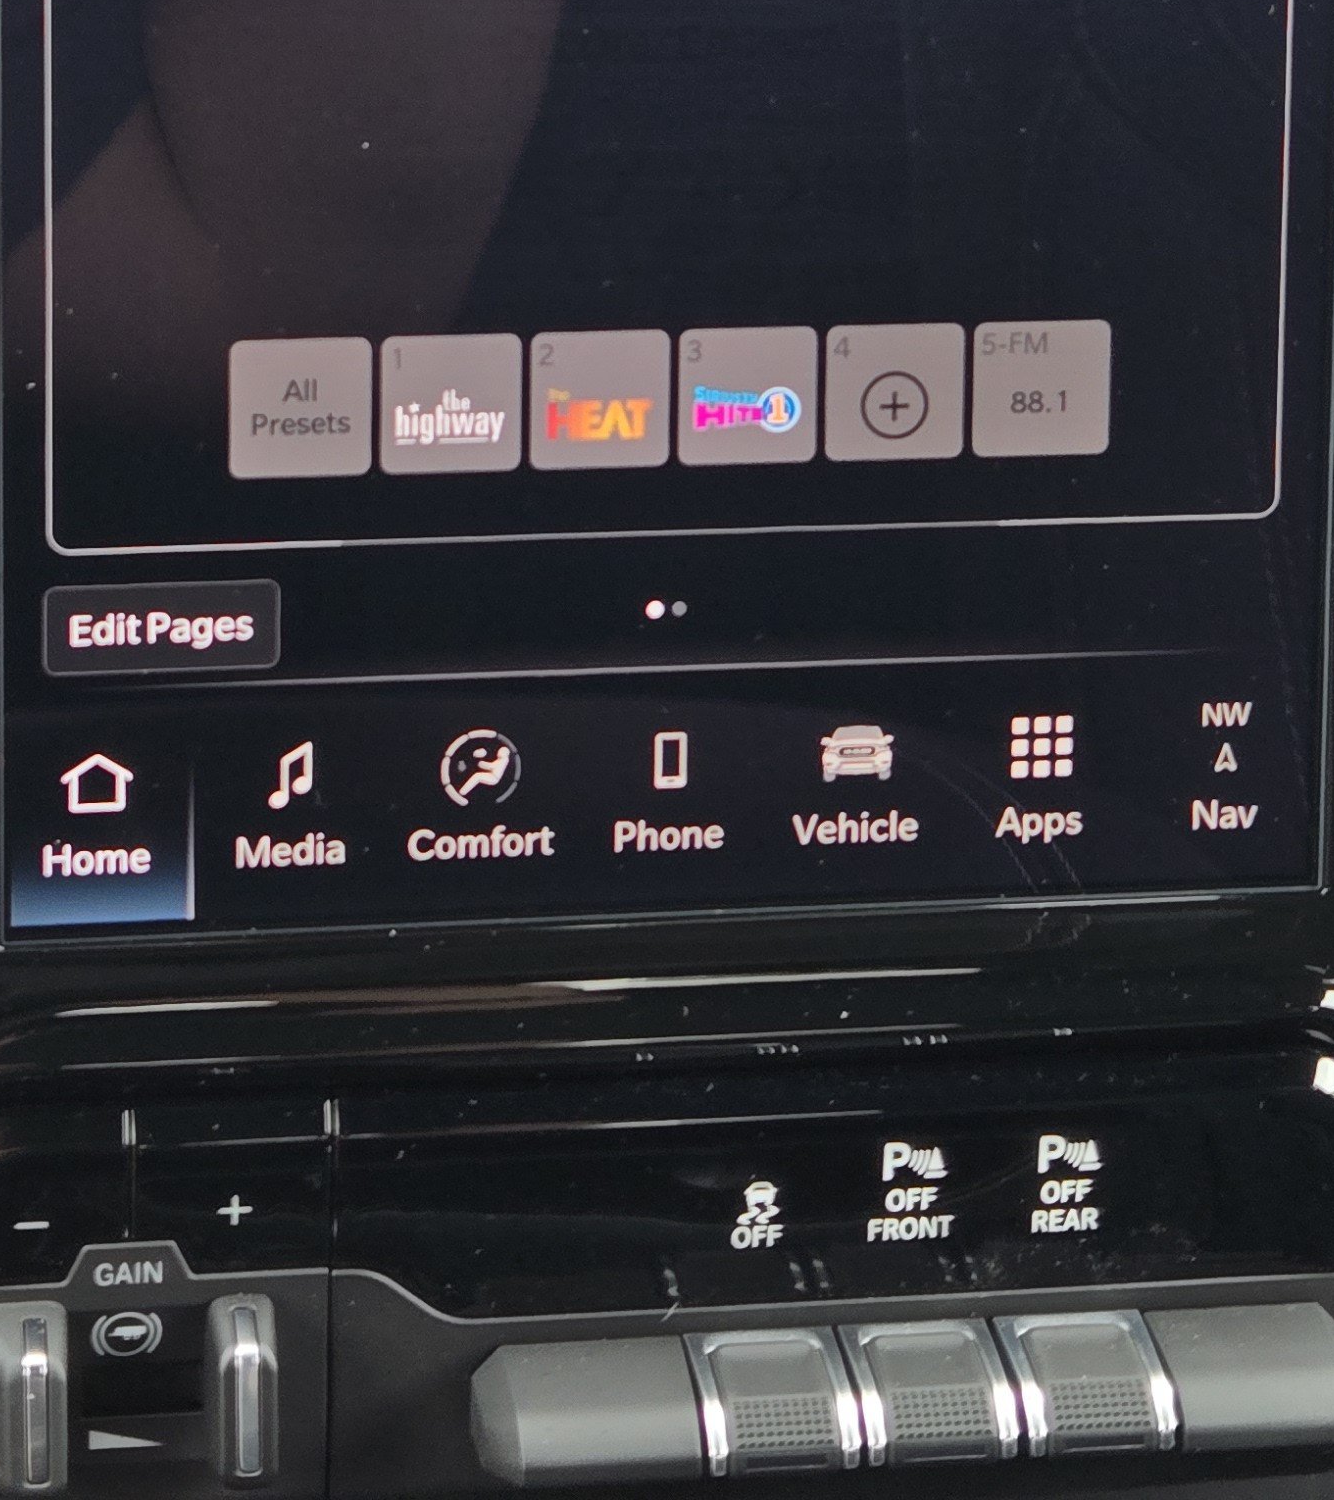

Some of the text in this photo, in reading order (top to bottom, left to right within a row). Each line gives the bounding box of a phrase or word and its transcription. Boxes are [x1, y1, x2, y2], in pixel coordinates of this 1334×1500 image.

[538, 343, 556, 367] 2
[686, 339, 703, 363] 3
[833, 336, 852, 359] 4
[981, 331, 1050, 356] 5-FM
[282, 378, 318, 403] All
[442, 389, 470, 412] the
[1010, 389, 1068, 414] 88.1
[250, 411, 352, 437] Presets
[394, 402, 506, 446] highway
[545, 399, 653, 442] HEAT
[68, 611, 255, 651] Edit Pages
[1201, 701, 1253, 728] NW
[792, 810, 920, 846] Vehicle
[995, 806, 1084, 844] Apps
[1190, 799, 1259, 831] Nav
[407, 825, 556, 862] Comfort
[613, 819, 725, 854] Phone
[41, 843, 152, 879] Home
[234, 832, 347, 870] Media
[884, 1186, 940, 1213] OFF
[1039, 1178, 1095, 1204] OFF
[867, 1214, 956, 1243] FRONT
[1030, 1206, 1101, 1234] REAR
[730, 1224, 785, 1250] OFF
[92, 1260, 164, 1288] GAIN
